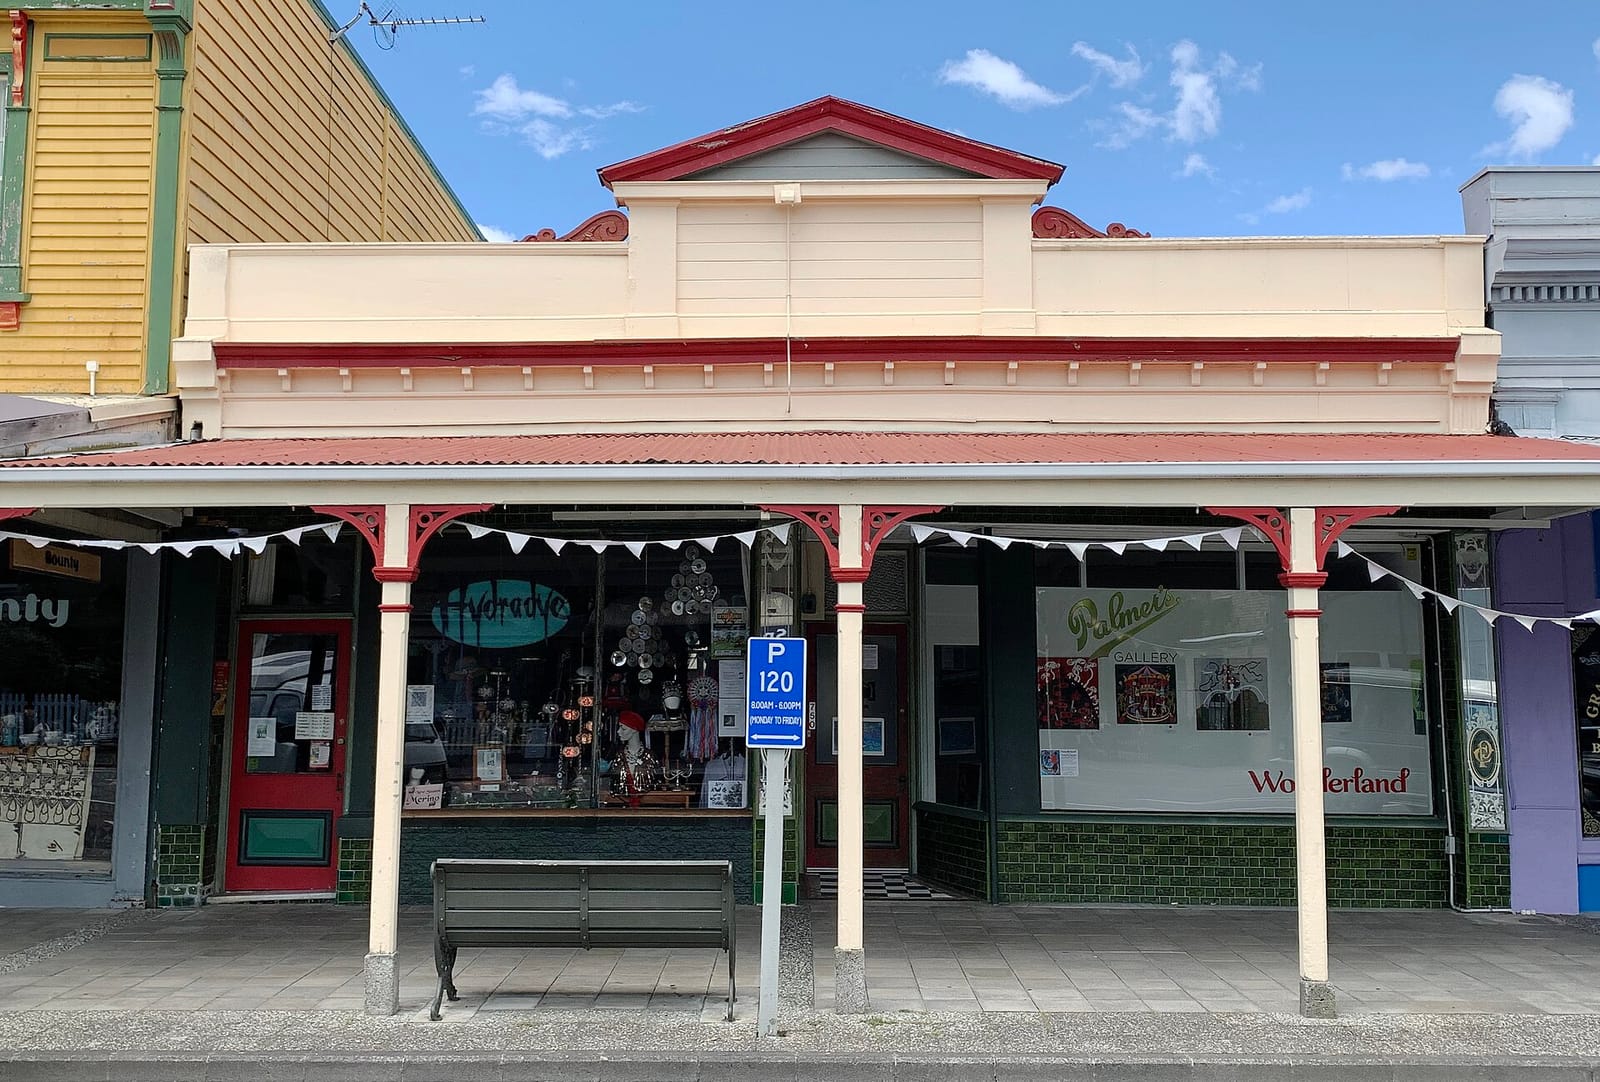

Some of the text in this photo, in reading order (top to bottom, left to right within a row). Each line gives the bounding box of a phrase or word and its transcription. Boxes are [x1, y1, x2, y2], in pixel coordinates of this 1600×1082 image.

[44, 549, 80, 572] Bounty
[768, 642, 786, 664] P
[1113, 651, 1178, 663] GALLERY
[759, 670, 794, 693] 120
[778, 701, 802, 710] 6.00PM
[774, 716, 782, 725] TO
[1247, 767, 1411, 794] Woderland
